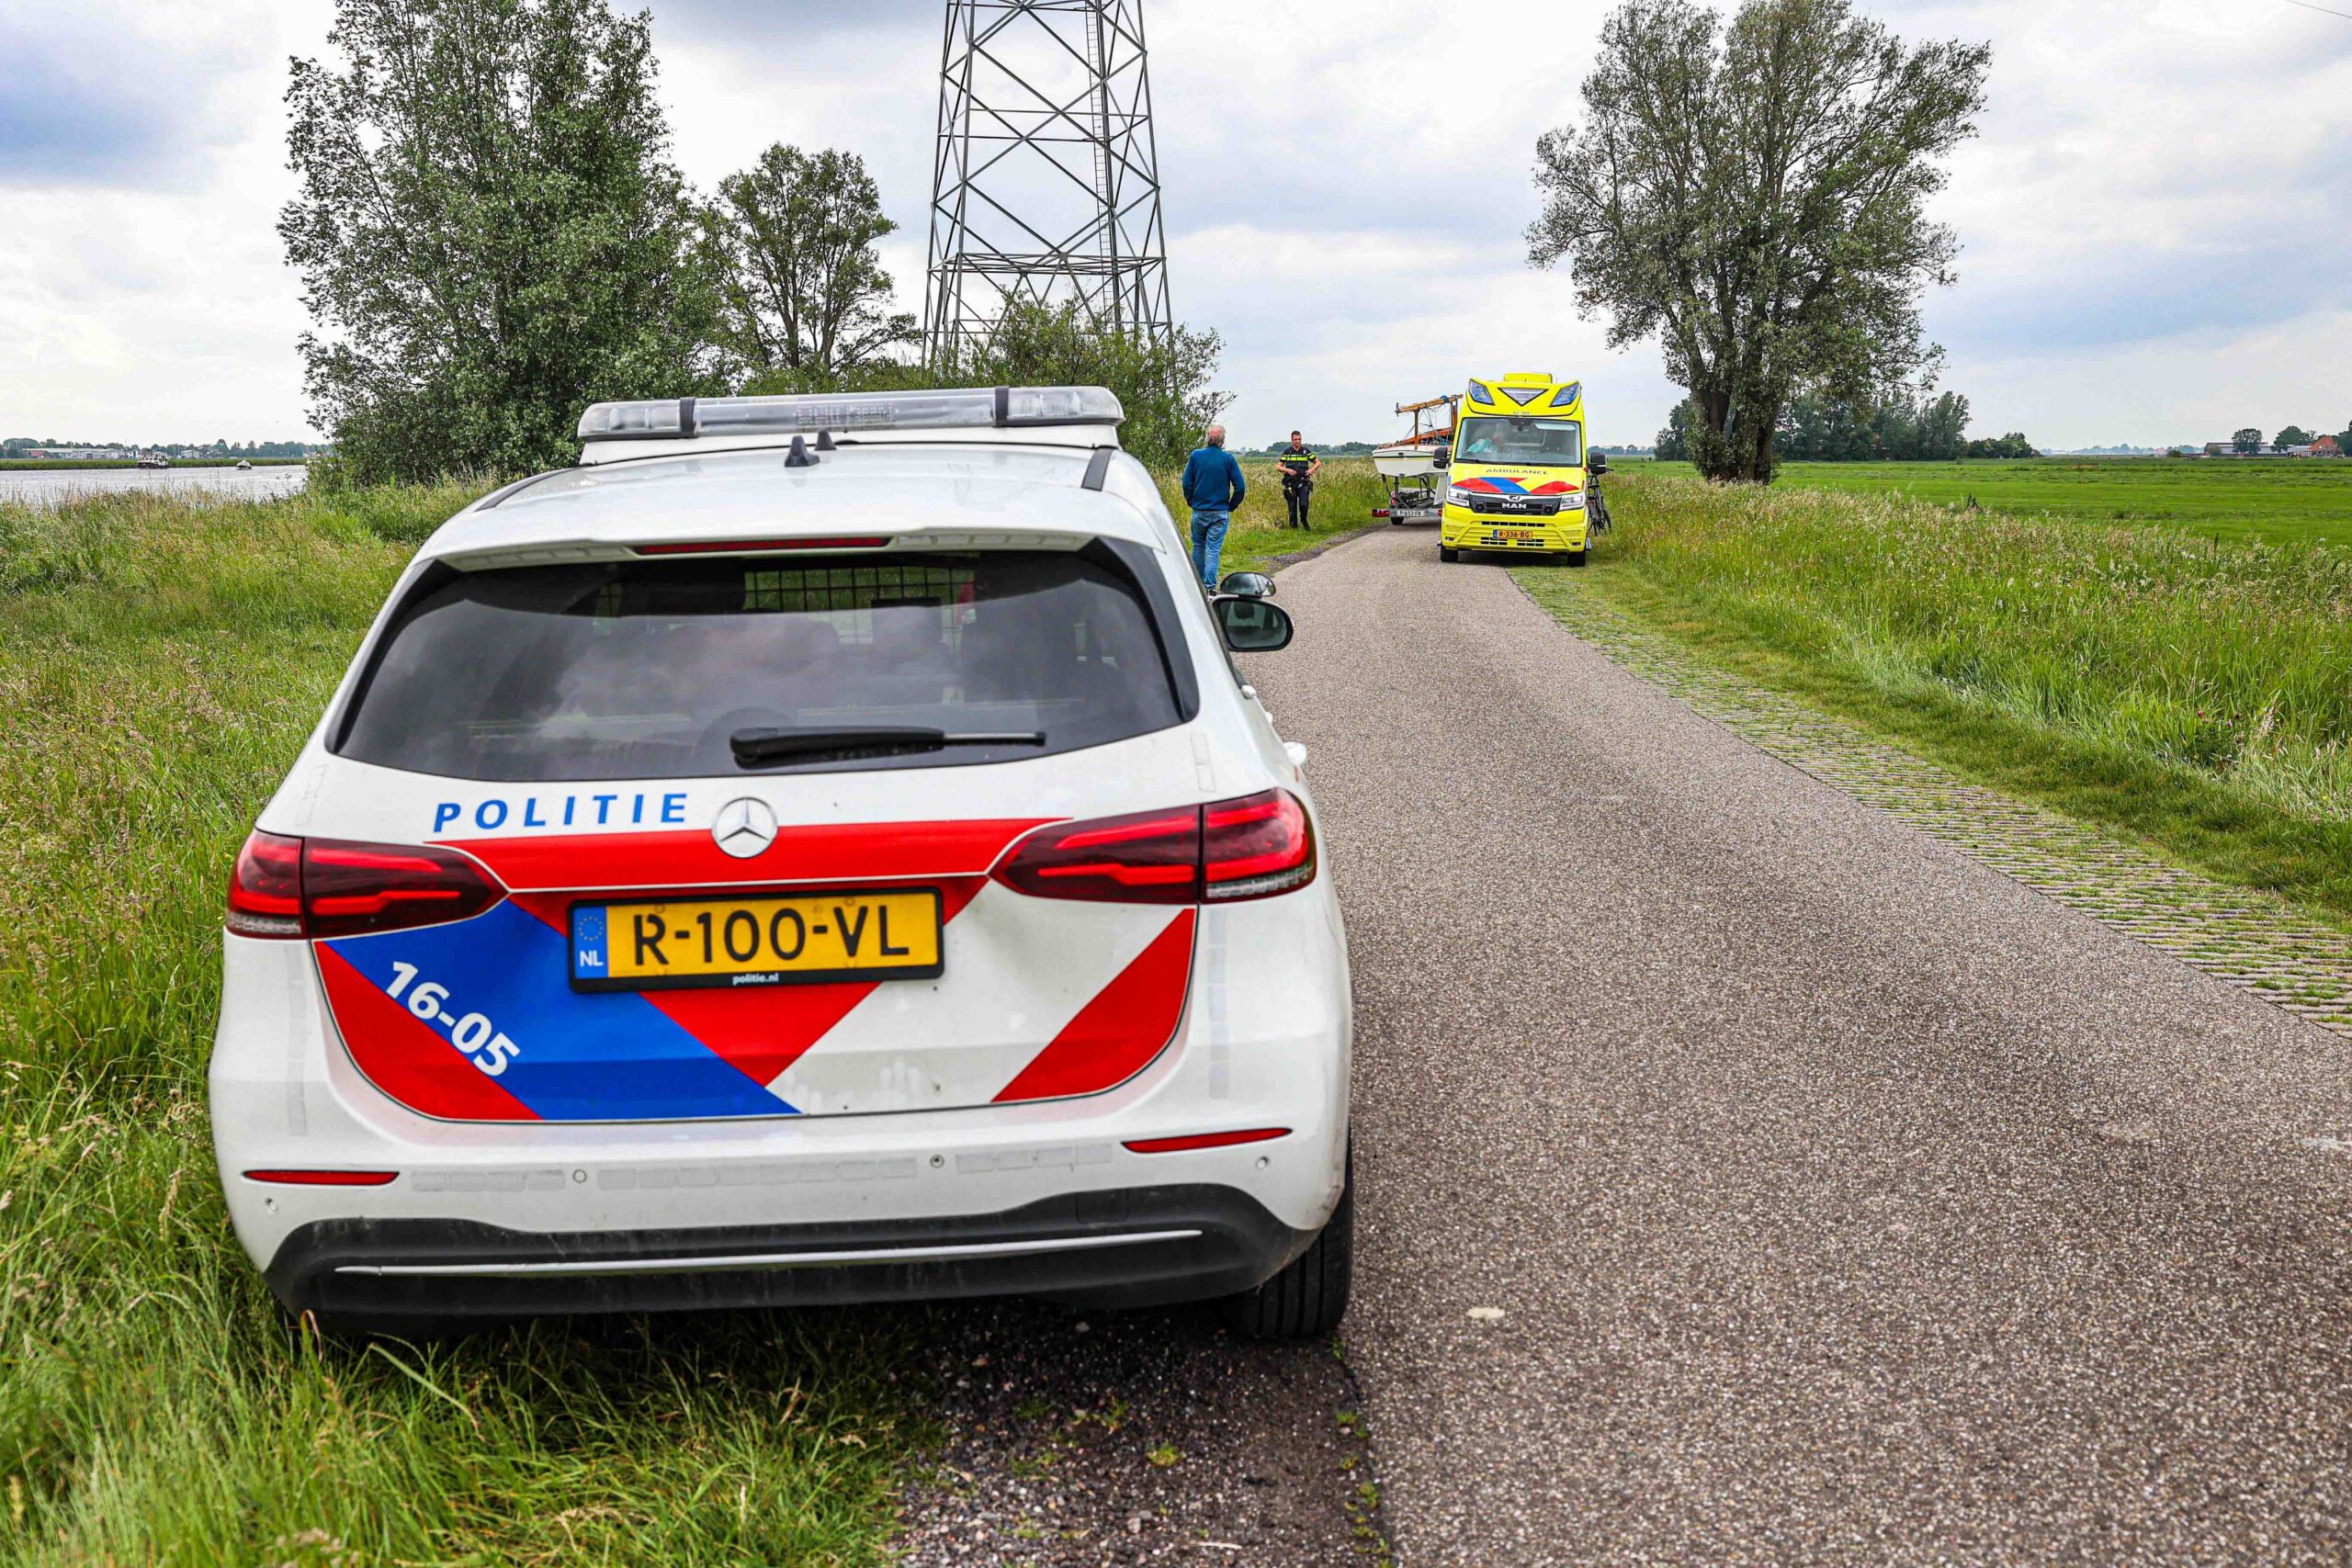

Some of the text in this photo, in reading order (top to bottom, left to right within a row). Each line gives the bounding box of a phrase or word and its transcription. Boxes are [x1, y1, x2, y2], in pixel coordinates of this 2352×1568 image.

[434, 794, 687, 833] POLITIE
[634, 905, 910, 965] R-100-VL
[580, 950, 604, 967] NL
[732, 972, 779, 986] politie.nl
[385, 961, 521, 1077] 16-05
